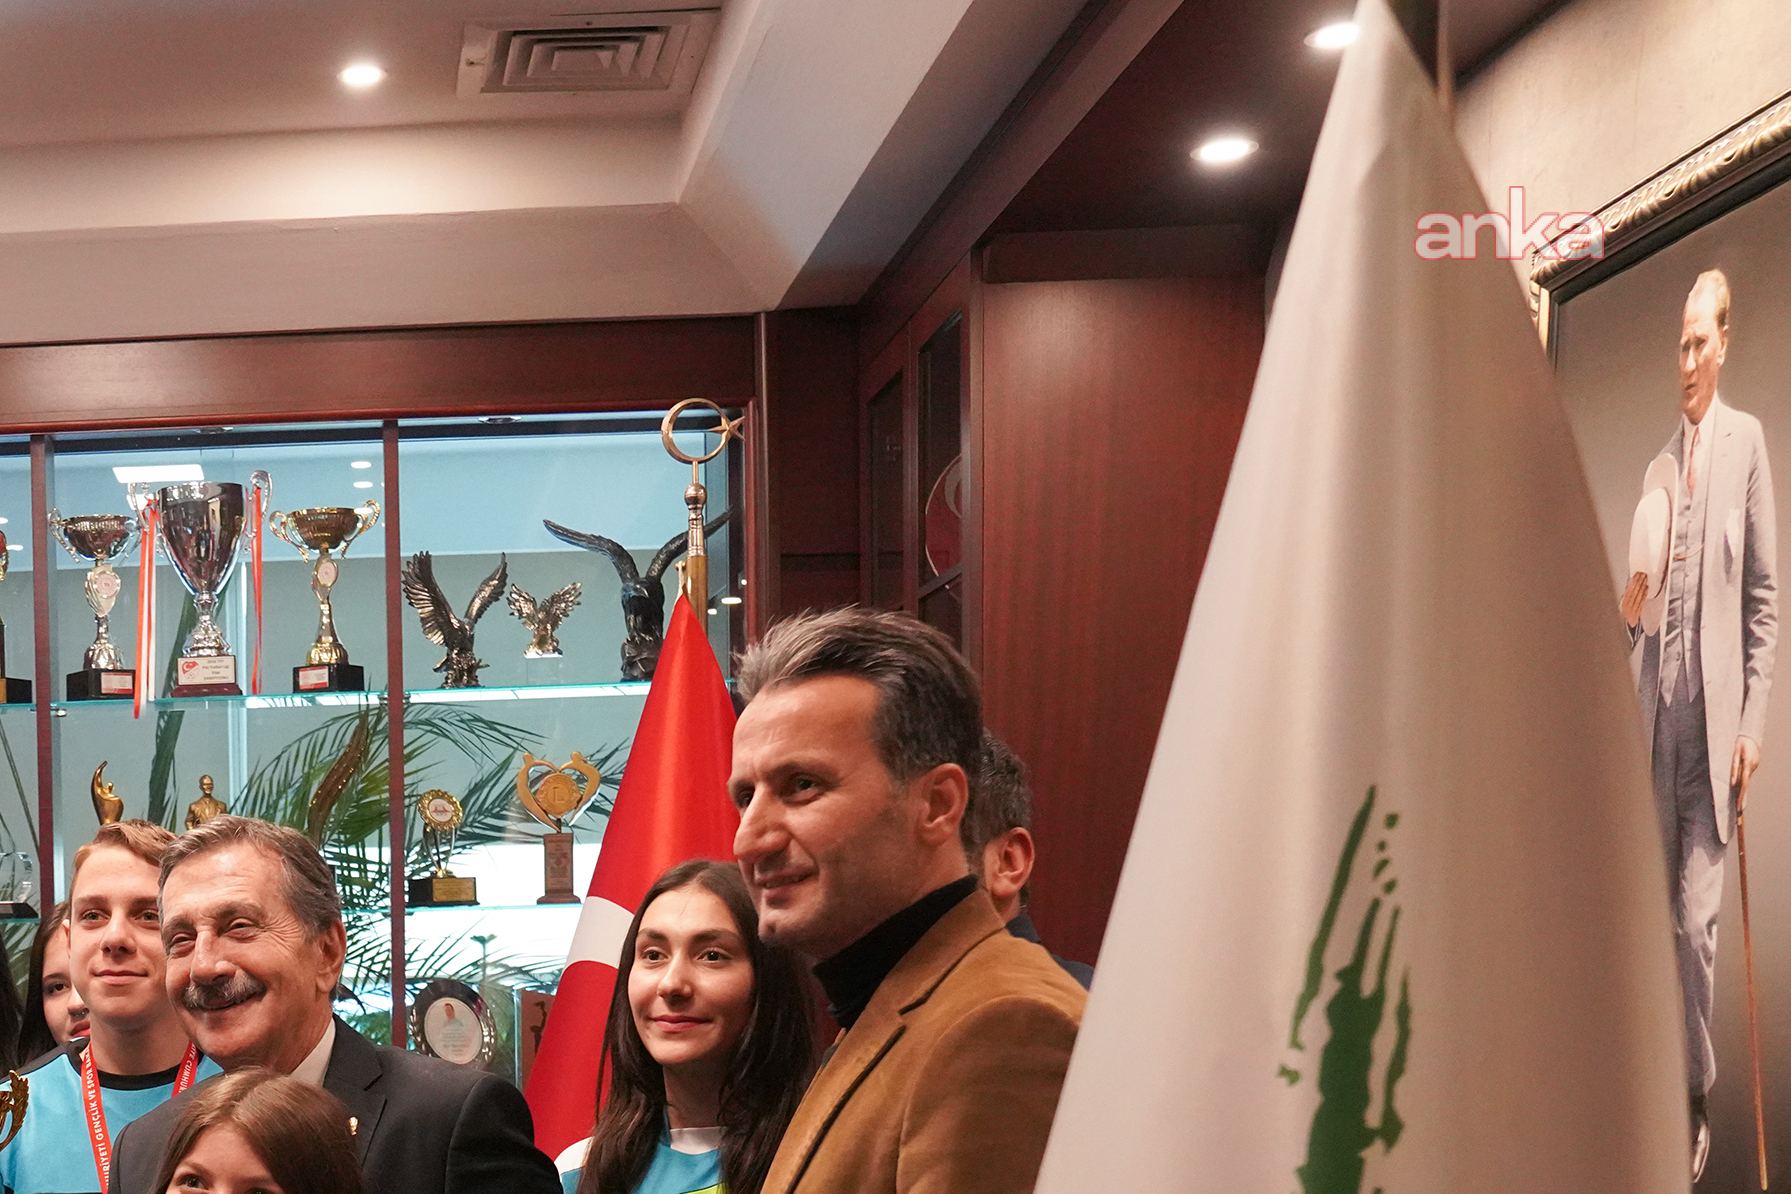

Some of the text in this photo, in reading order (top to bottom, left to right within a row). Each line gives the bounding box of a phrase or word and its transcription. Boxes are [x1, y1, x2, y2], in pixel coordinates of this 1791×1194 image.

[86, 1068, 95, 1089] SPOR
[88, 1089, 96, 1101] VE
[88, 1100, 104, 1141] GENÇLİK
